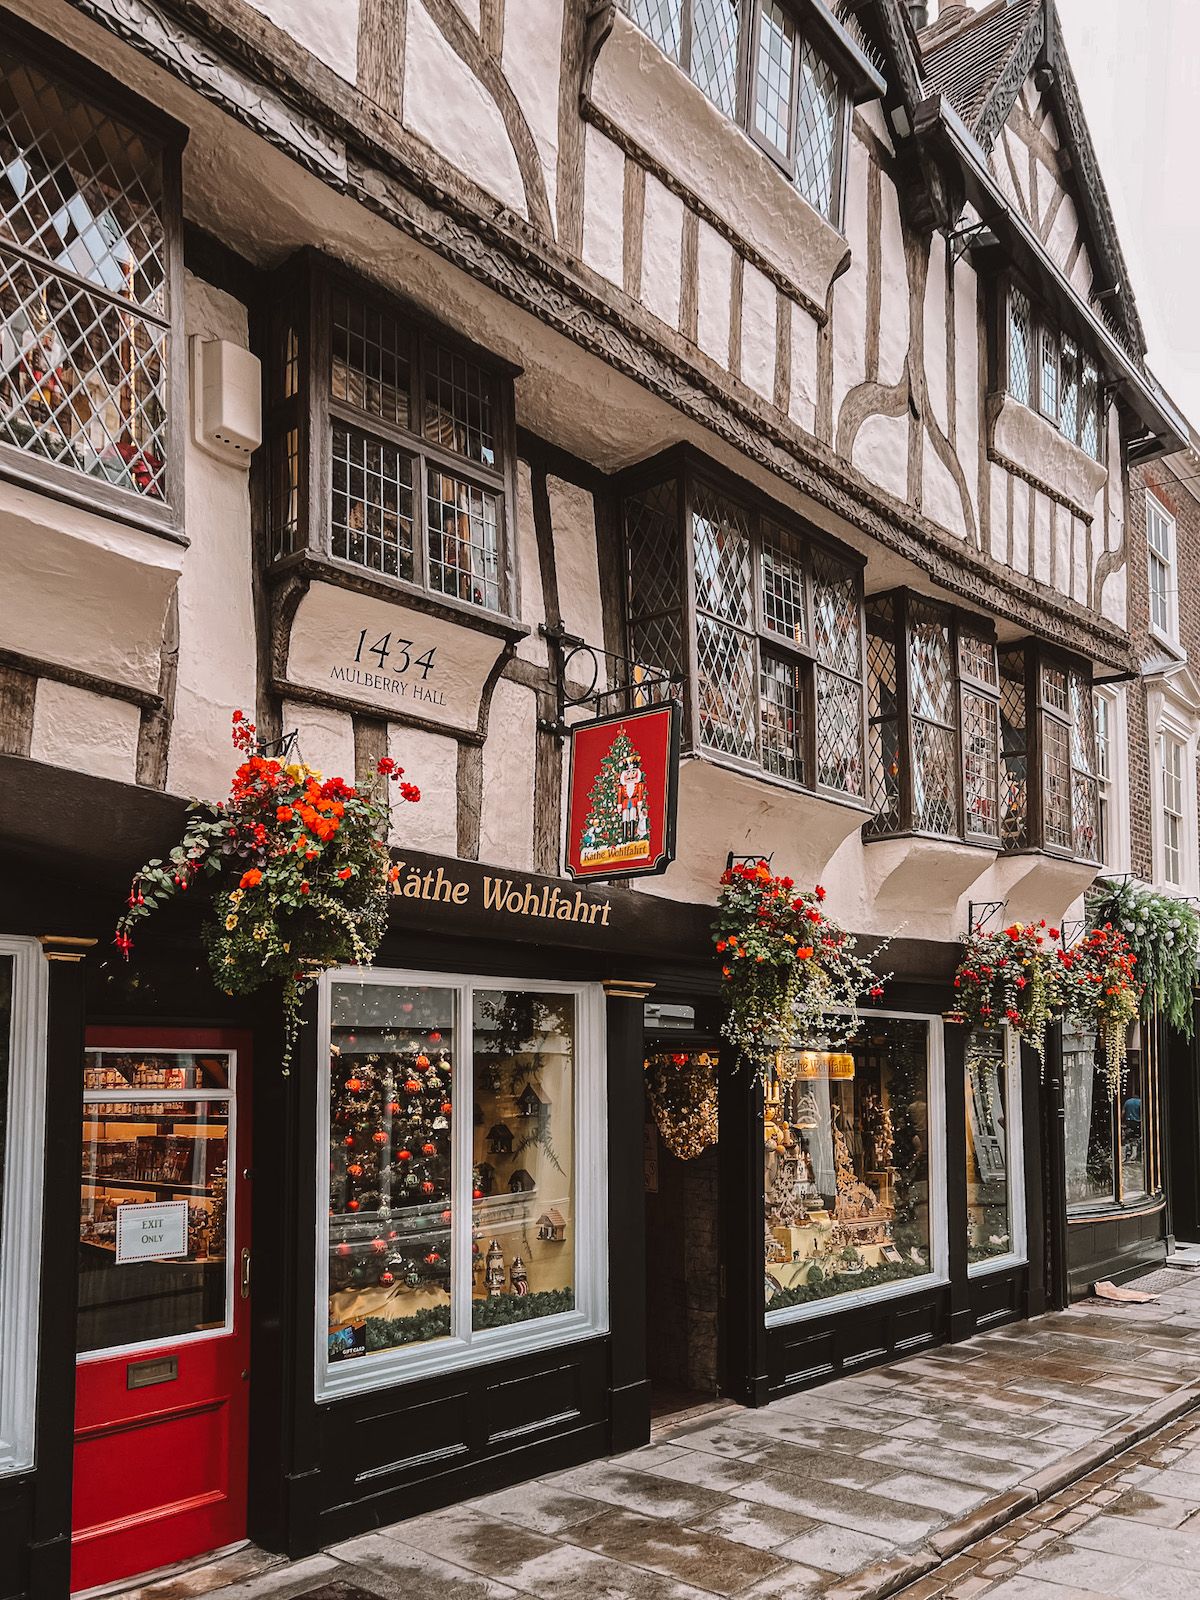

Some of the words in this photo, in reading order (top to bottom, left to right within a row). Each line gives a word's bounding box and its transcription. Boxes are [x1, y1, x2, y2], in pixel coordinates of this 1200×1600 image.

[354, 629, 437, 680] 1434
[330, 666, 408, 695] MULBERRY
[413, 685, 447, 706] HALL
[608, 845, 646, 857] Wohlfahrt
[483, 876, 612, 926] Wohlfahrt
[142, 1219, 164, 1229] EXIT
